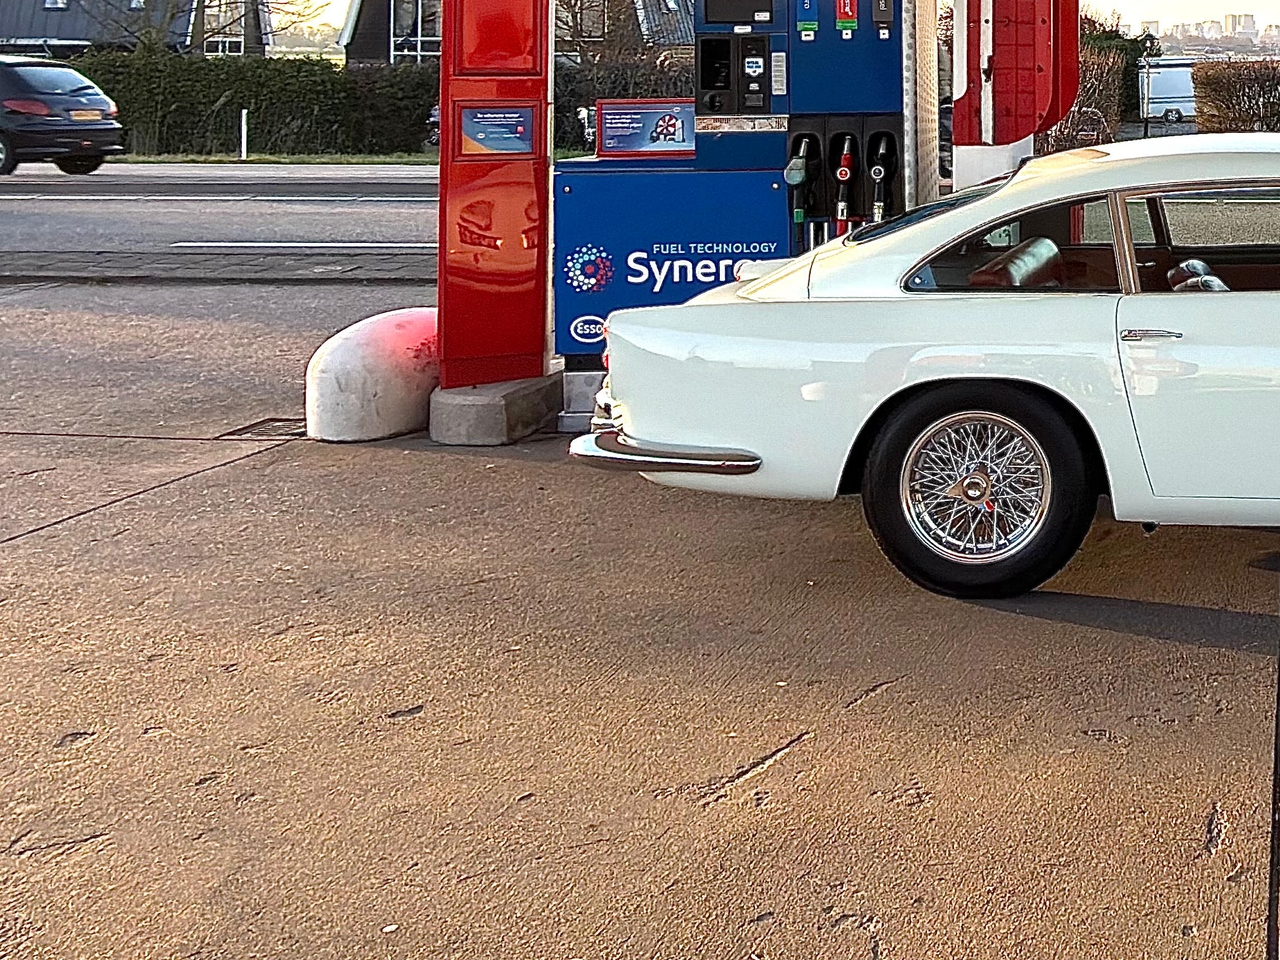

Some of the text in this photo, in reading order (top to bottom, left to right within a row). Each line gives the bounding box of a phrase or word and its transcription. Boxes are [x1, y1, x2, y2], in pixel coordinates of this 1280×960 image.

[653, 242, 777, 254] FUEL TECHNOLOGY
[627, 252, 762, 292] Syner
[576, 322, 604, 335] Esso
